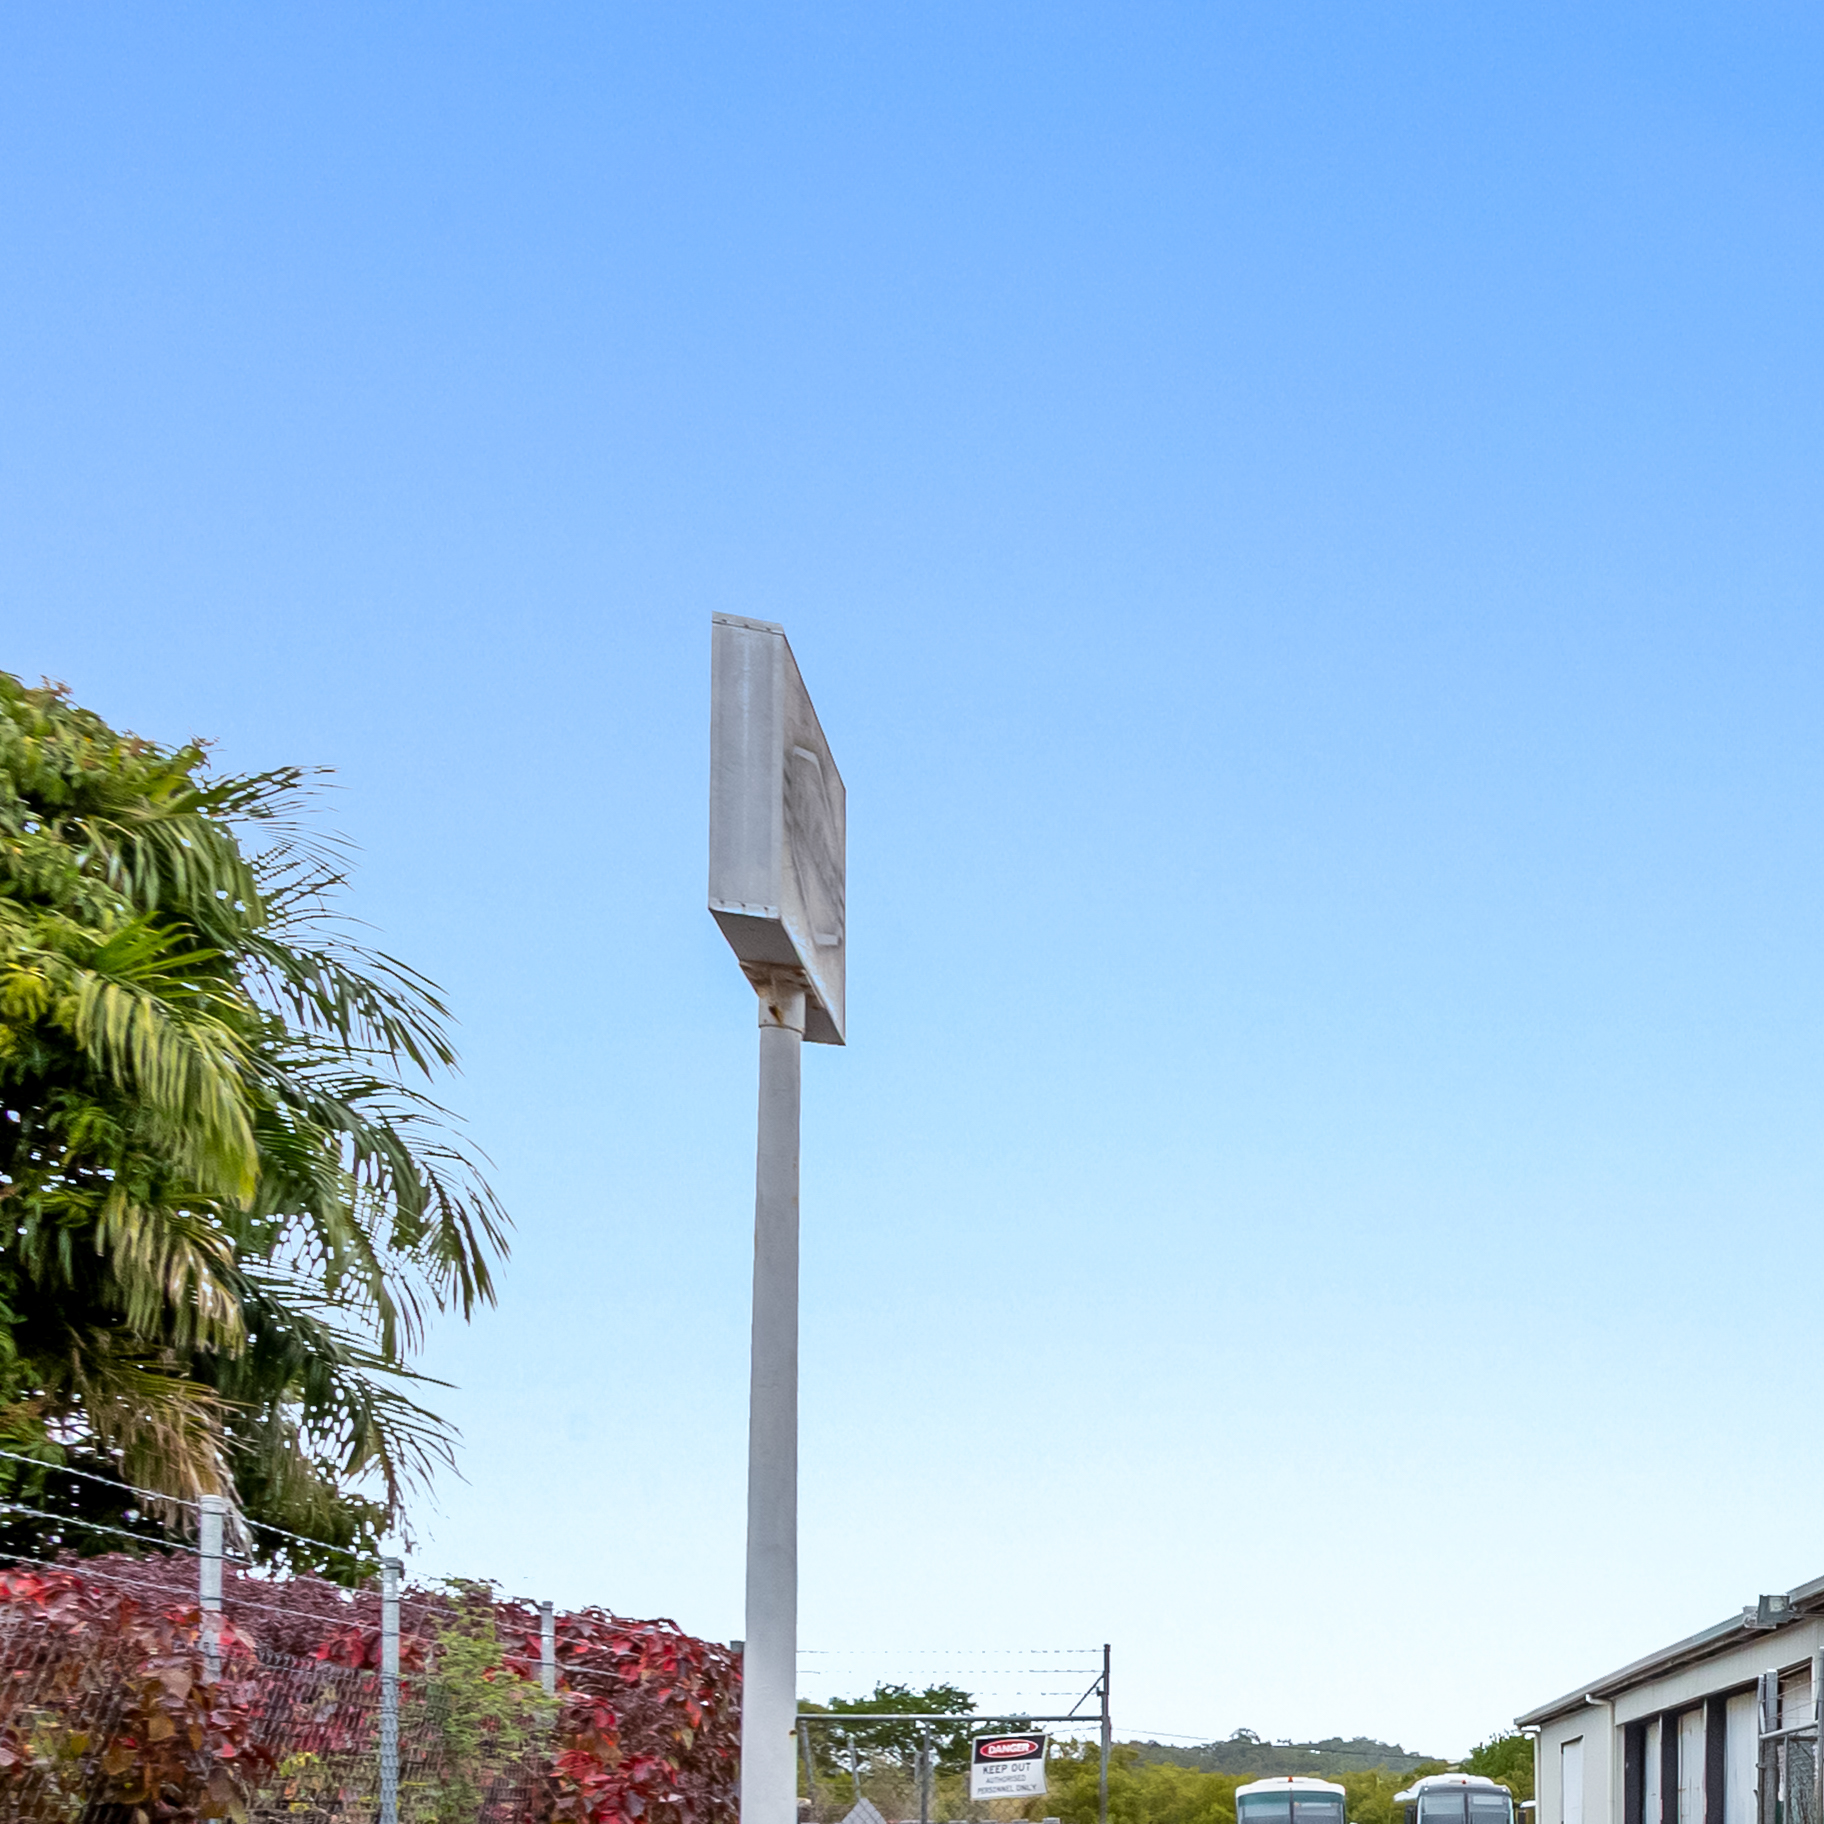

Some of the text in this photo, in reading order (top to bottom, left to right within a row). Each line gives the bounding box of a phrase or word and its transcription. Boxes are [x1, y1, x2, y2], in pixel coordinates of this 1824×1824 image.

[988, 1743, 1030, 1754] DANGER
[983, 1762, 1031, 1774] KEEP OUT
